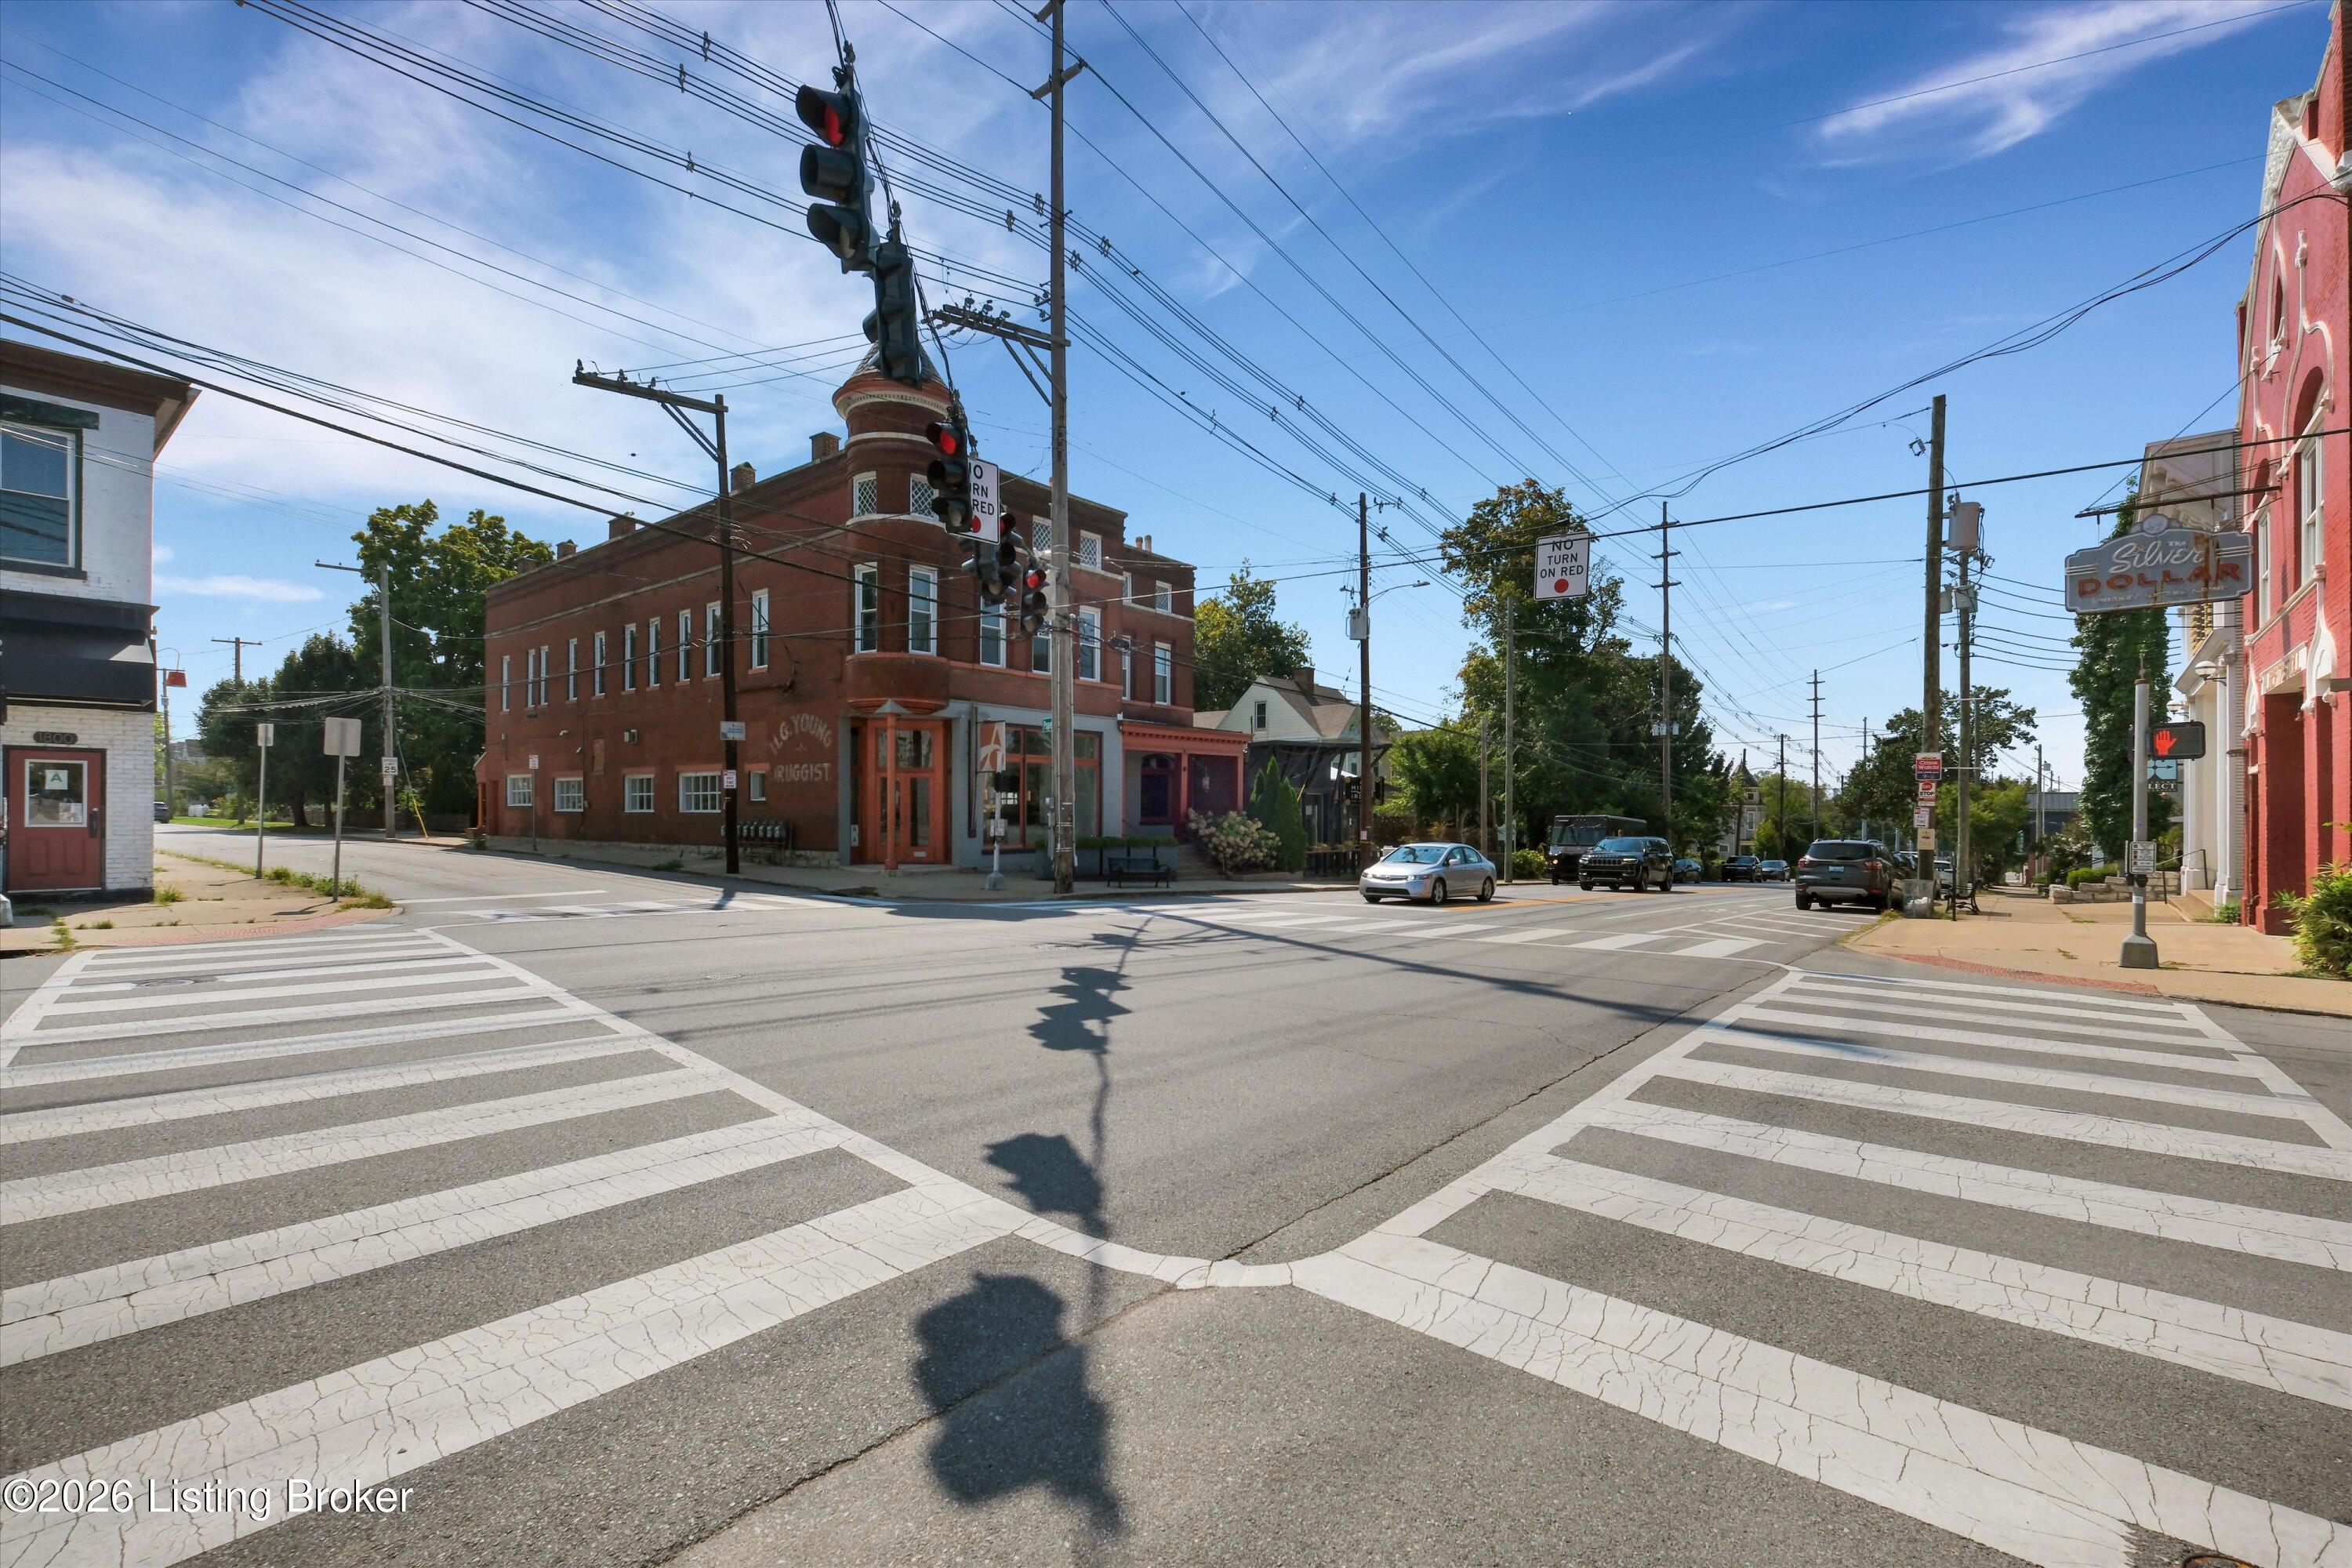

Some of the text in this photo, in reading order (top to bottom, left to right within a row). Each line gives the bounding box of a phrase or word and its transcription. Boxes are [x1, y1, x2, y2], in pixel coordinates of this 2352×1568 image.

[972, 483, 988, 499] RN
[972, 499, 994, 515] RED
[1552, 539, 1573, 552] NO
[1547, 553, 1577, 565] TURN
[1540, 565, 1584, 579] ON RED
[2078, 562, 2241, 597] DOLLAR
[790, 713, 833, 748] YOUNG
[38, 732, 74, 744] 1800
[50, 773, 63, 782] A
